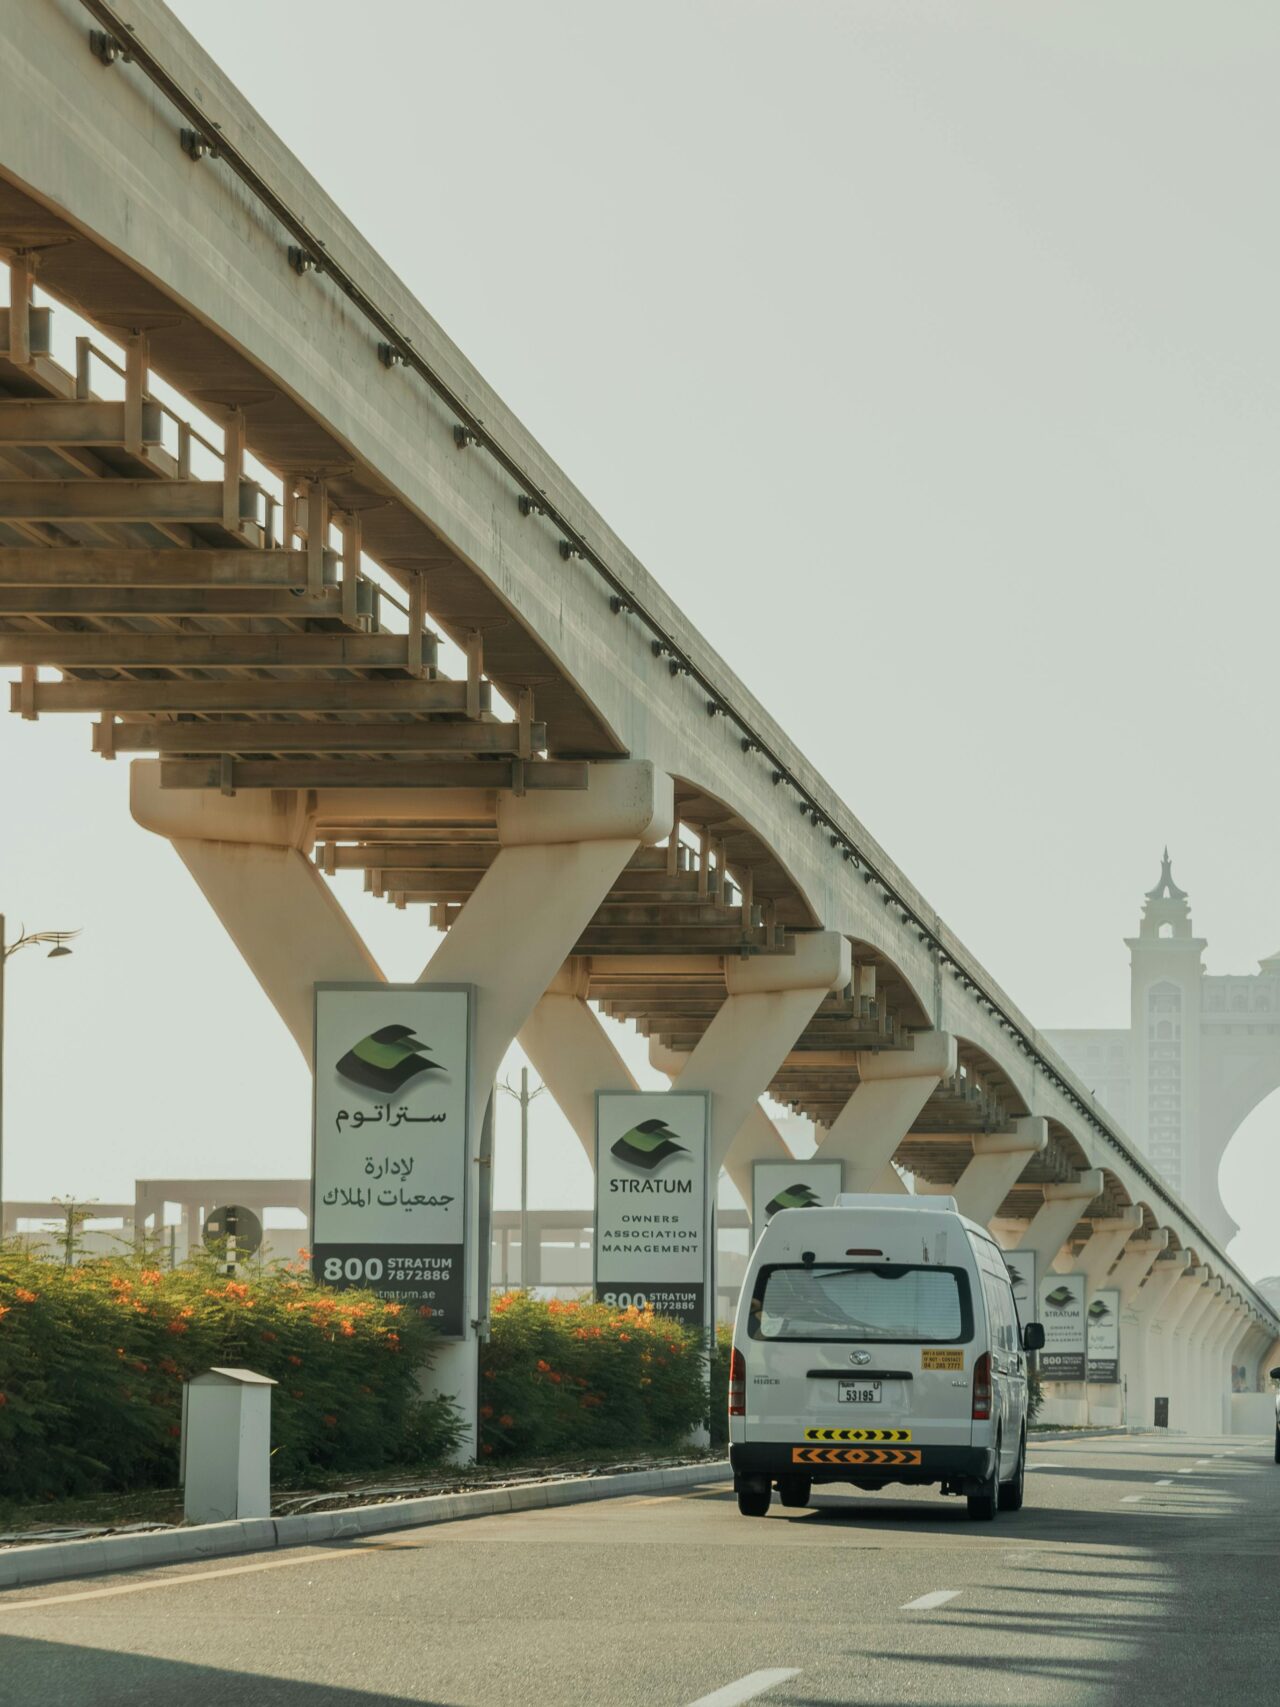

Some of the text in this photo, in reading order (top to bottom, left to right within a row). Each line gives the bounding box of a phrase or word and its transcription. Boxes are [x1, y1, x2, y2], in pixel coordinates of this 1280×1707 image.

[364, 1156, 415, 1182] لإدارة
[609, 1178, 693, 1194] STRATUM
[322, 1187, 455, 1212] جمعيات الملاك
[621, 1215, 680, 1224] OWNERS
[603, 1230, 698, 1239] ASSOCIATION
[602, 1245, 699, 1253] MANAGEMENT
[323, 1257, 452, 1281] 800 STRATUM
[387, 1270, 450, 1281] 7872886
[603, 1292, 697, 1311] 800 STRATUM
[1044, 1310, 1080, 1318] STRATUM
[1042, 1356, 1062, 1366] 800
[873, 1382, 880, 1390] U
[846, 1390, 874, 1402] 53195
